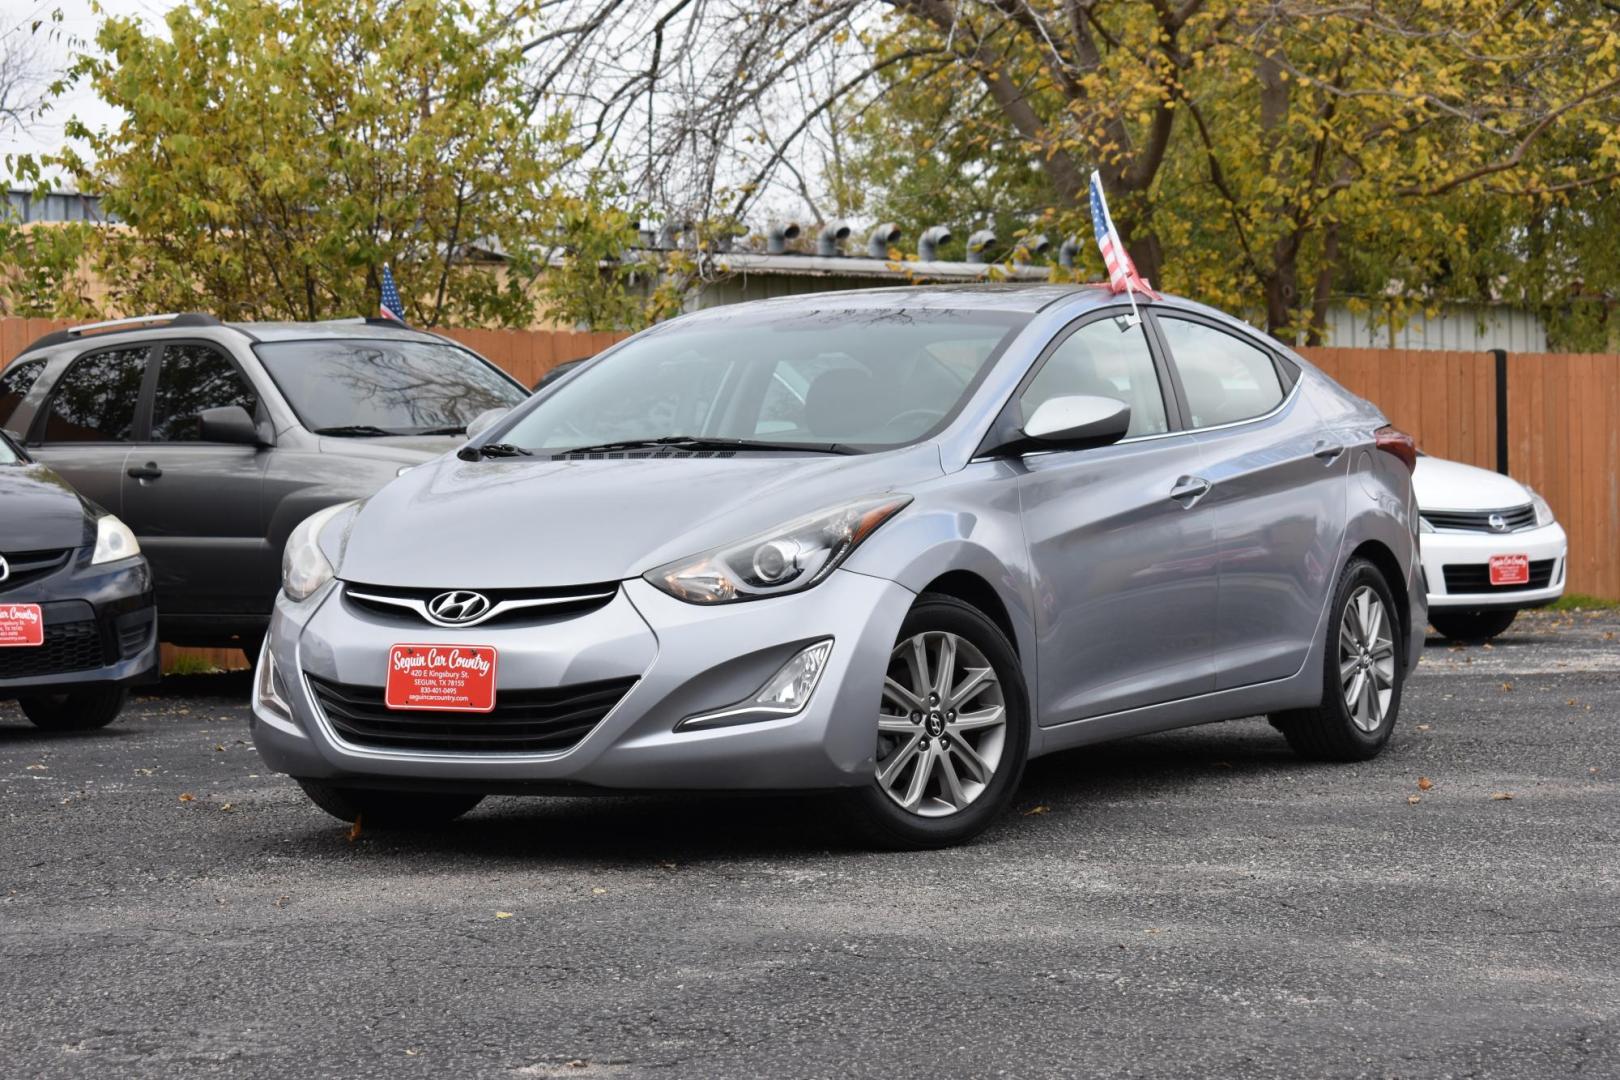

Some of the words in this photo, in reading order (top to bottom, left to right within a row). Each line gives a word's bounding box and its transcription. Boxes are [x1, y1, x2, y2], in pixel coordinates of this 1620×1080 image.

[394, 651, 426, 674] Seguin
[427, 648, 447, 668] Car
[448, 649, 490, 677] Country
[411, 669, 422, 677] 420
[429, 670, 459, 679] Kingsbury
[460, 670, 469, 679] St.
[409, 694, 469, 702] seguincarcountry.com
